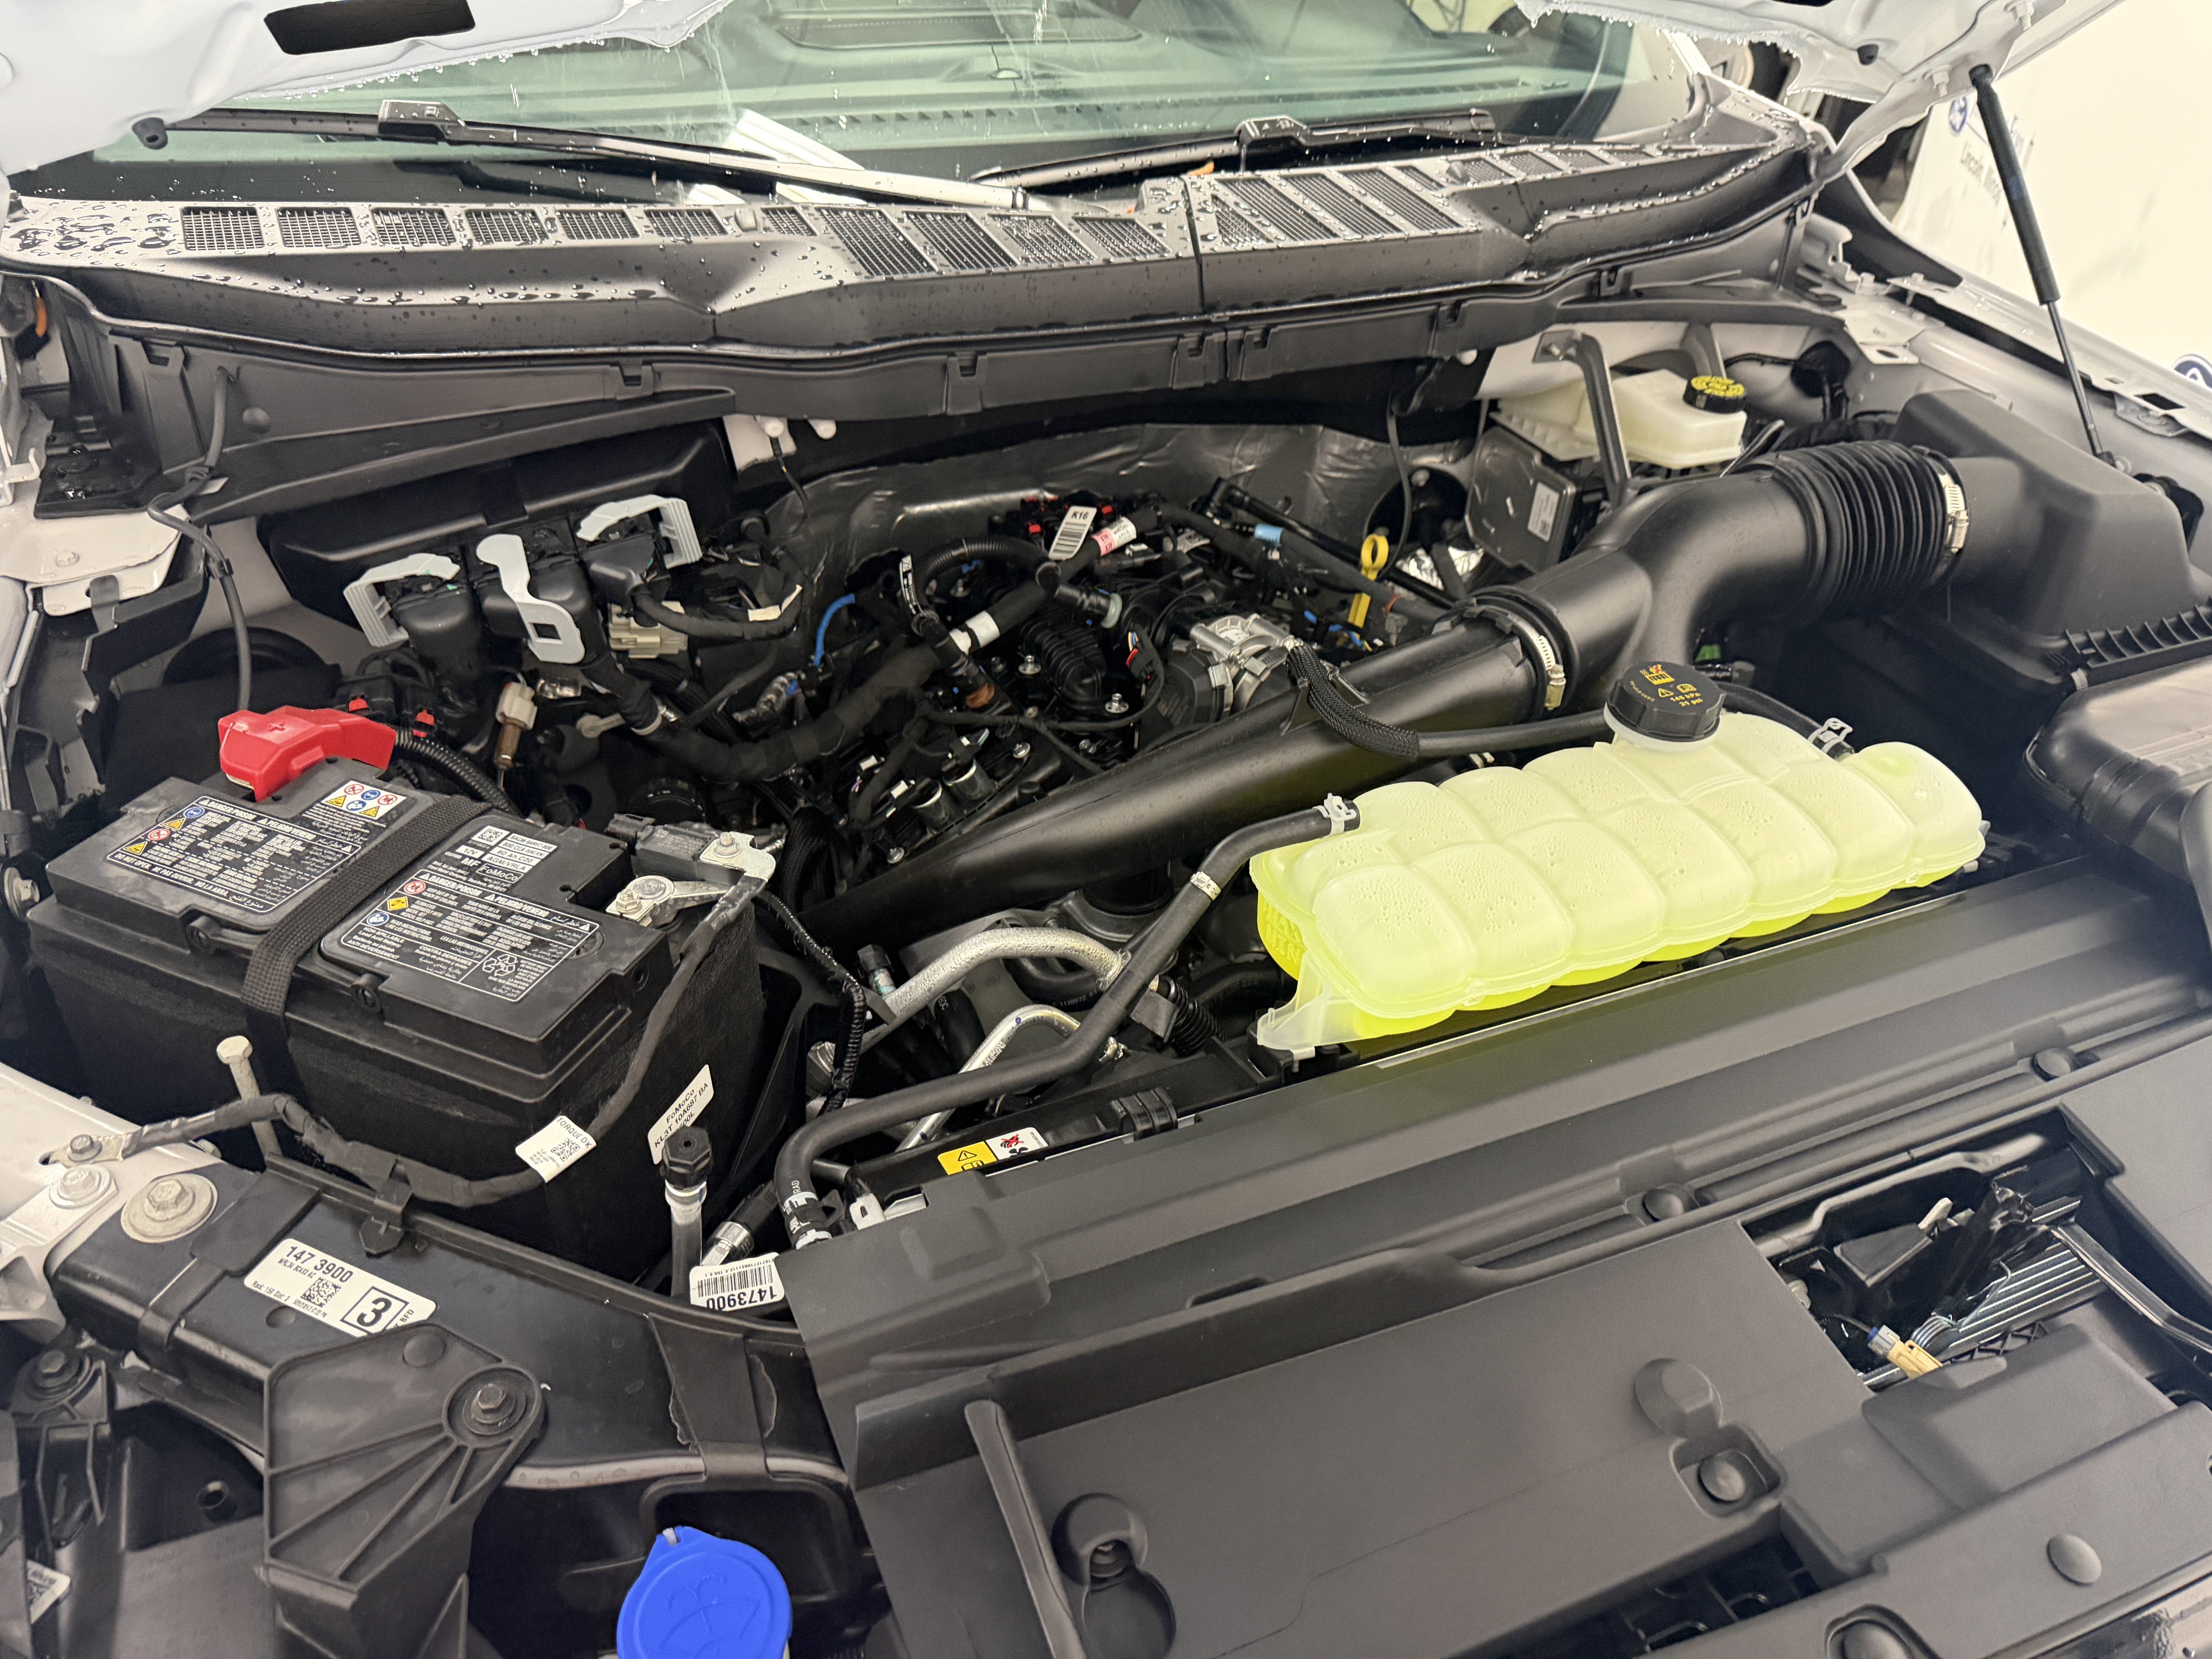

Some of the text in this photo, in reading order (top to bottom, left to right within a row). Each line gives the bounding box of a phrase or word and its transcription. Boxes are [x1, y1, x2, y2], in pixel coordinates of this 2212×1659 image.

[1072, 511, 1089, 520] K16
[207, 802, 256, 820] DANGER/POISON
[266, 821, 316, 840] PELIGRO/VENENO
[461, 858, 481, 866] MF
[479, 866, 520, 882] FoMoCo
[487, 857, 526, 870] AGM/VRLA
[134, 860, 151, 869] OPEN.
[171, 873, 194, 884] OUVRIR.
[211, 887, 228, 896] ABRA.
[429, 876, 482, 896] DANGER/POISON
[495, 897, 549, 917] PELIGRO/VENENO
[364, 927, 405, 943] NON-SPILLABLE
[1264, 902, 1300, 943] MAX
[353, 935, 372, 944] Batterie
[383, 939, 401, 948] Battery
[1265, 923, 1300, 965] MIN
[419, 946, 472, 965] CONTRA DERRAMES
[655, 1083, 708, 1148] KL3T 10A687 BA
[667, 1090, 694, 1123] FoMoCo
[557, 1118, 592, 1149] TORQUE OK
[792, 1180, 802, 1194] RAD
[287, 1247, 353, 1282] 147 3900
[706, 1287, 776, 1312] 1473900
[357, 1298, 392, 1327] 3
[400, 1310, 414, 1322] BFD
